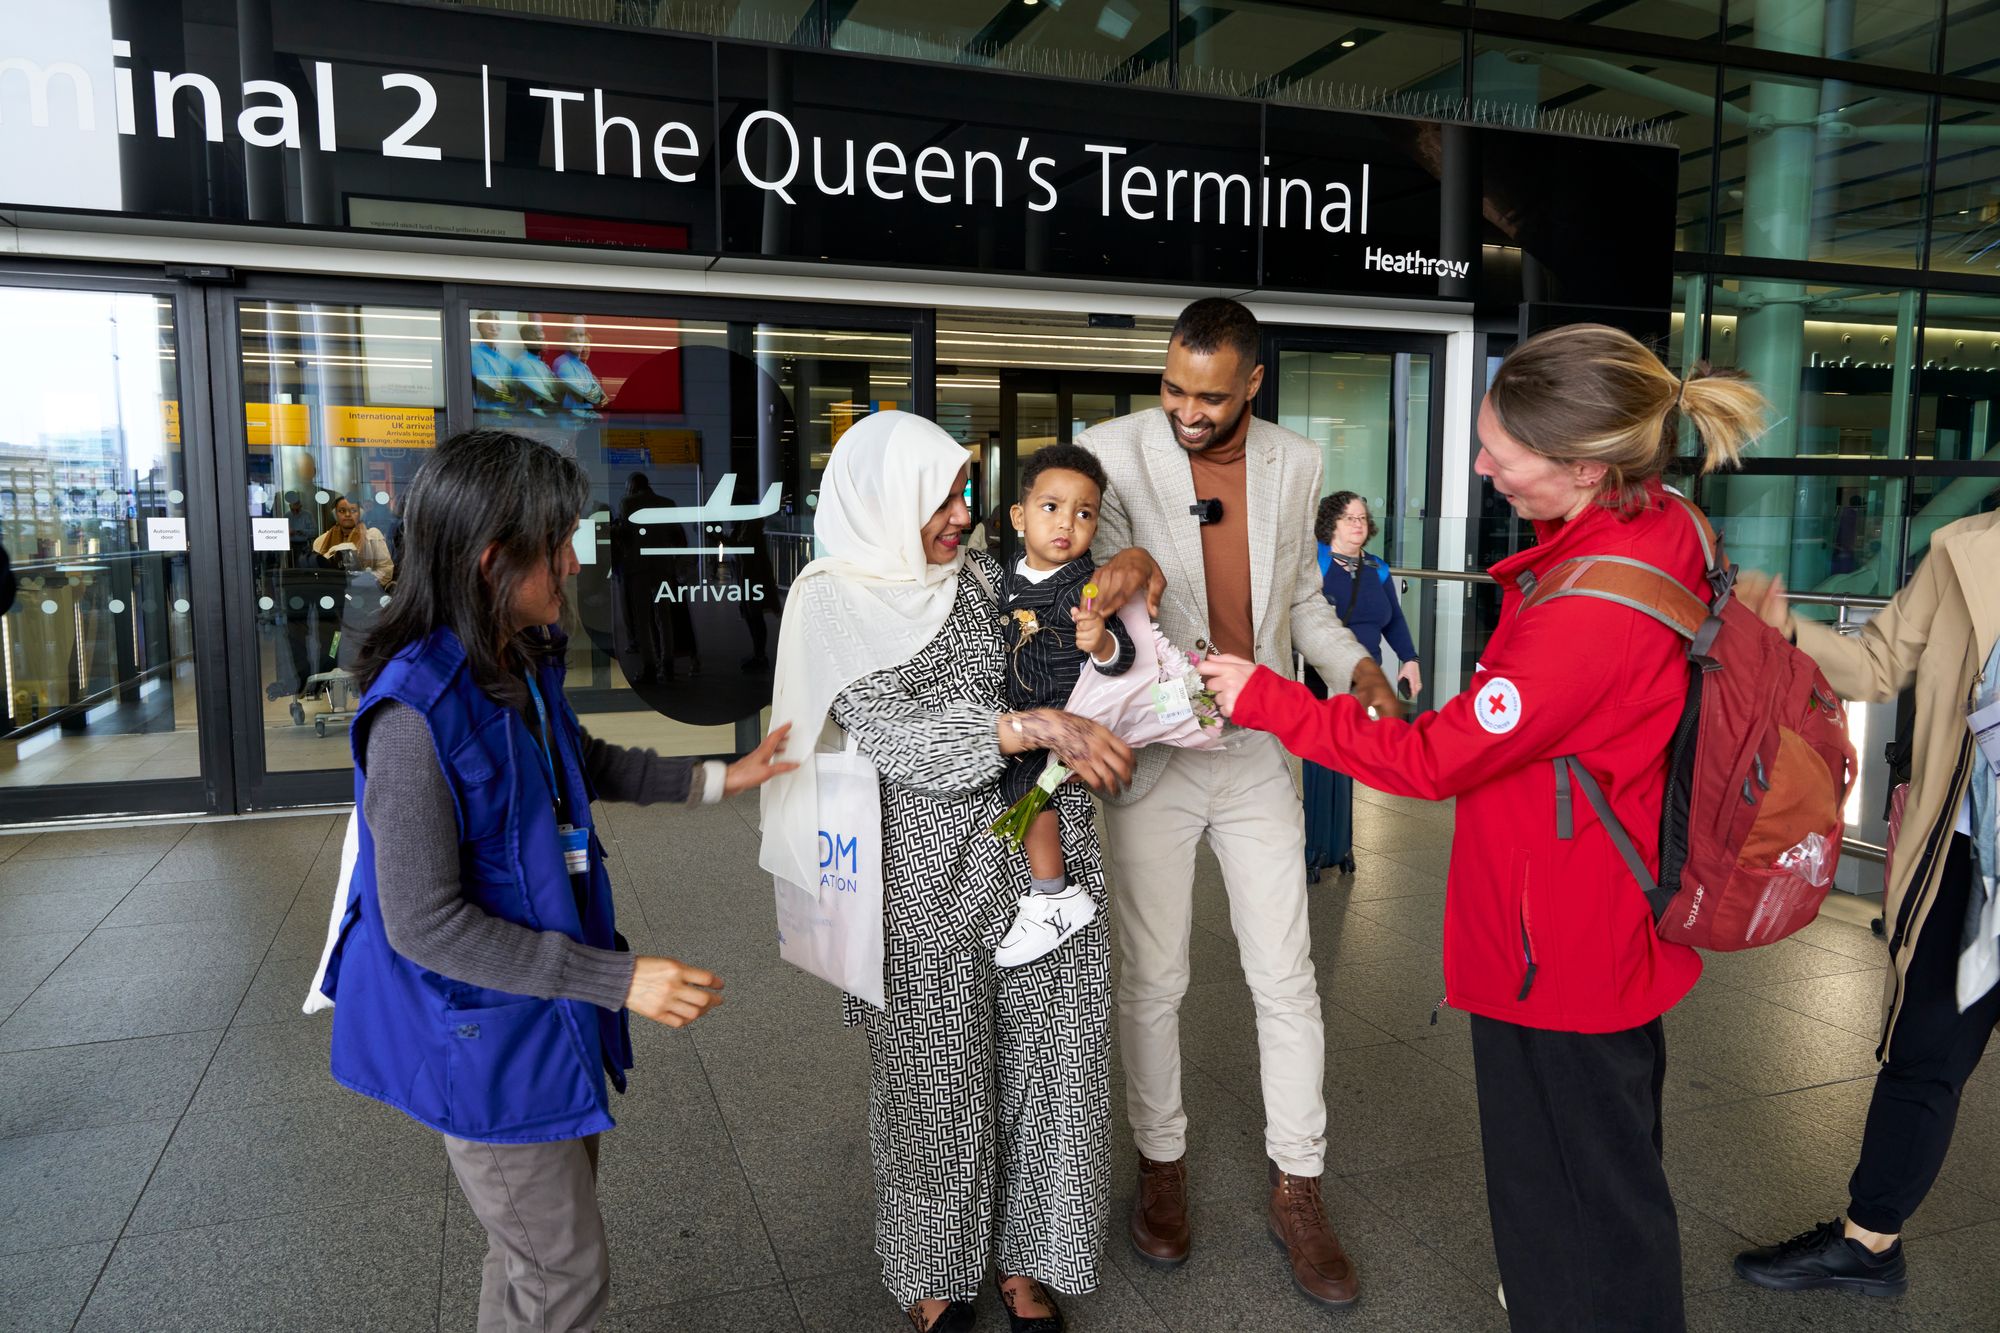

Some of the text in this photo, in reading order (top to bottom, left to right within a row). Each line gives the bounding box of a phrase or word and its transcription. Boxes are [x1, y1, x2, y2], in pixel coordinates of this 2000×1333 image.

[382, 73, 442, 161] 2
[529, 88, 700, 183] The
[736, 110, 1058, 212] Queen's
[1085, 144, 1370, 234] Terminal
[1365, 246, 1470, 278] Heathrow
[349, 412, 404, 422] International
[391, 421, 404, 429] UK
[654, 579, 765, 603] Arrivals
